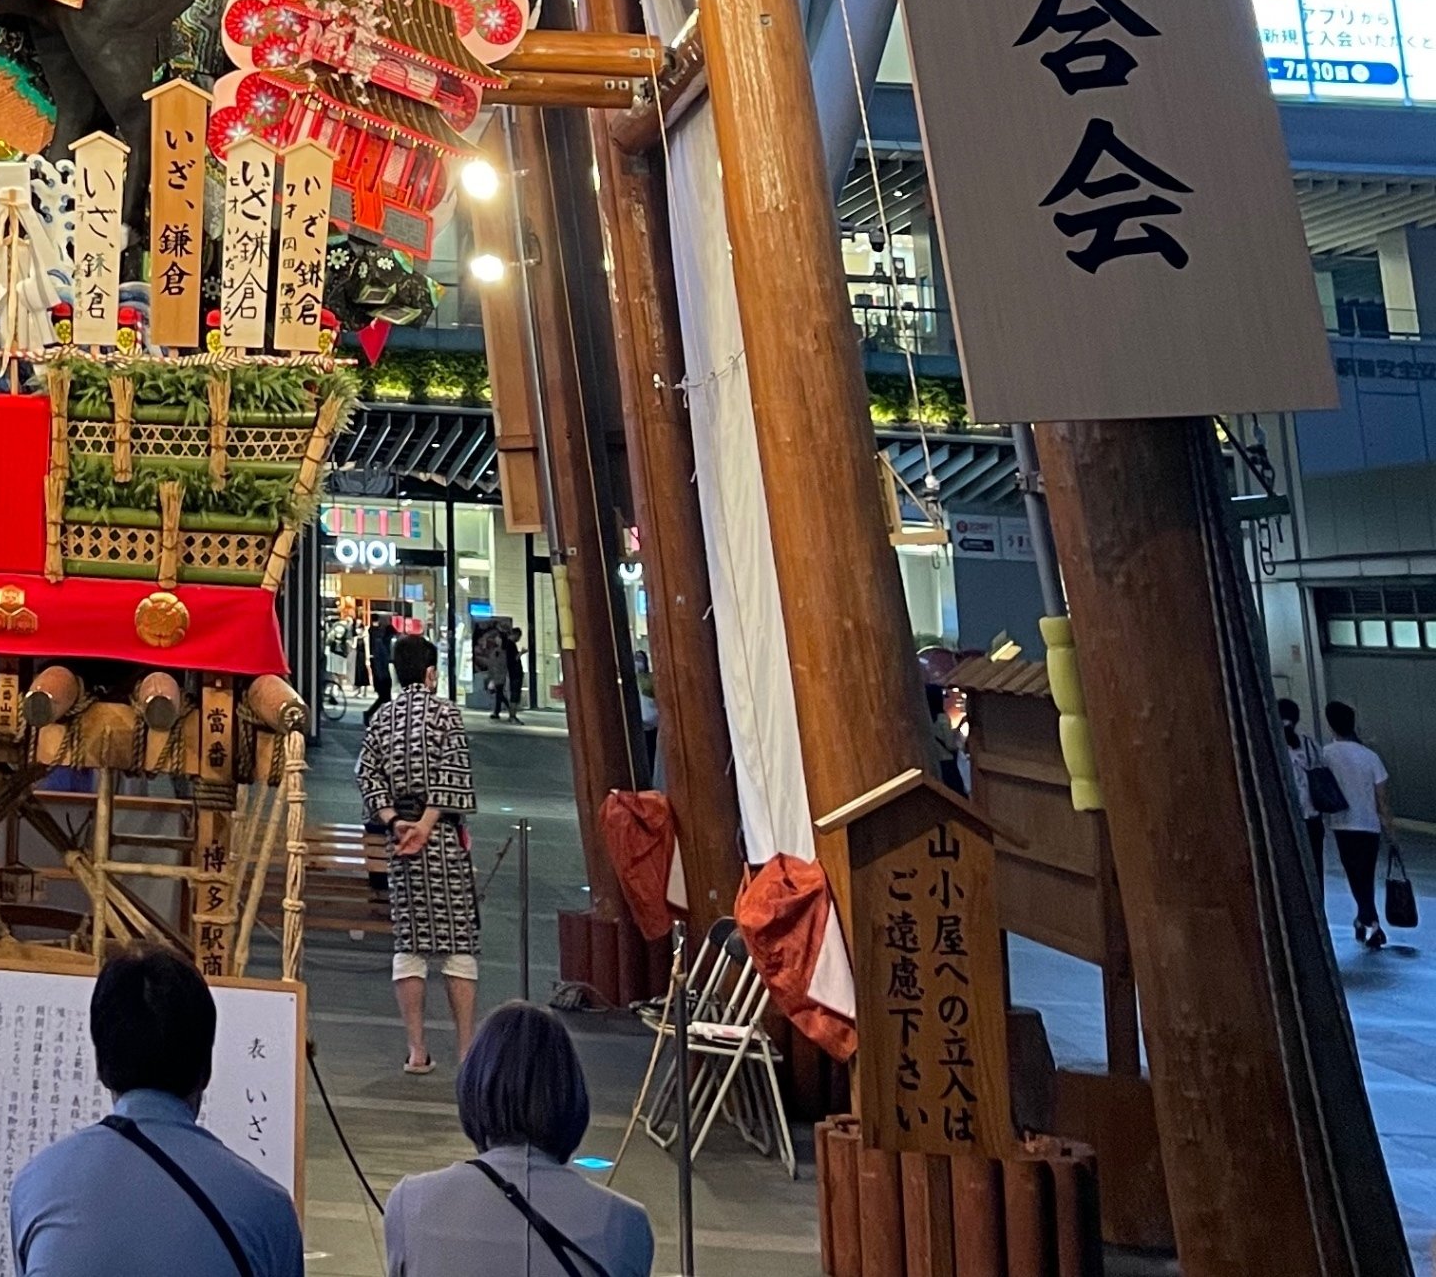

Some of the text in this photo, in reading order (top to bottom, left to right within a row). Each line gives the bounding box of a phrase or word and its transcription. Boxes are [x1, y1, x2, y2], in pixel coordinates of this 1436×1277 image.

[158, 130, 195, 296] いざ、鎌倉
[248, 1038, 266, 1059] 表
[884, 870, 928, 1134] ご遠慮下さい
[927, 823, 977, 1145] 山小屋への立入は
